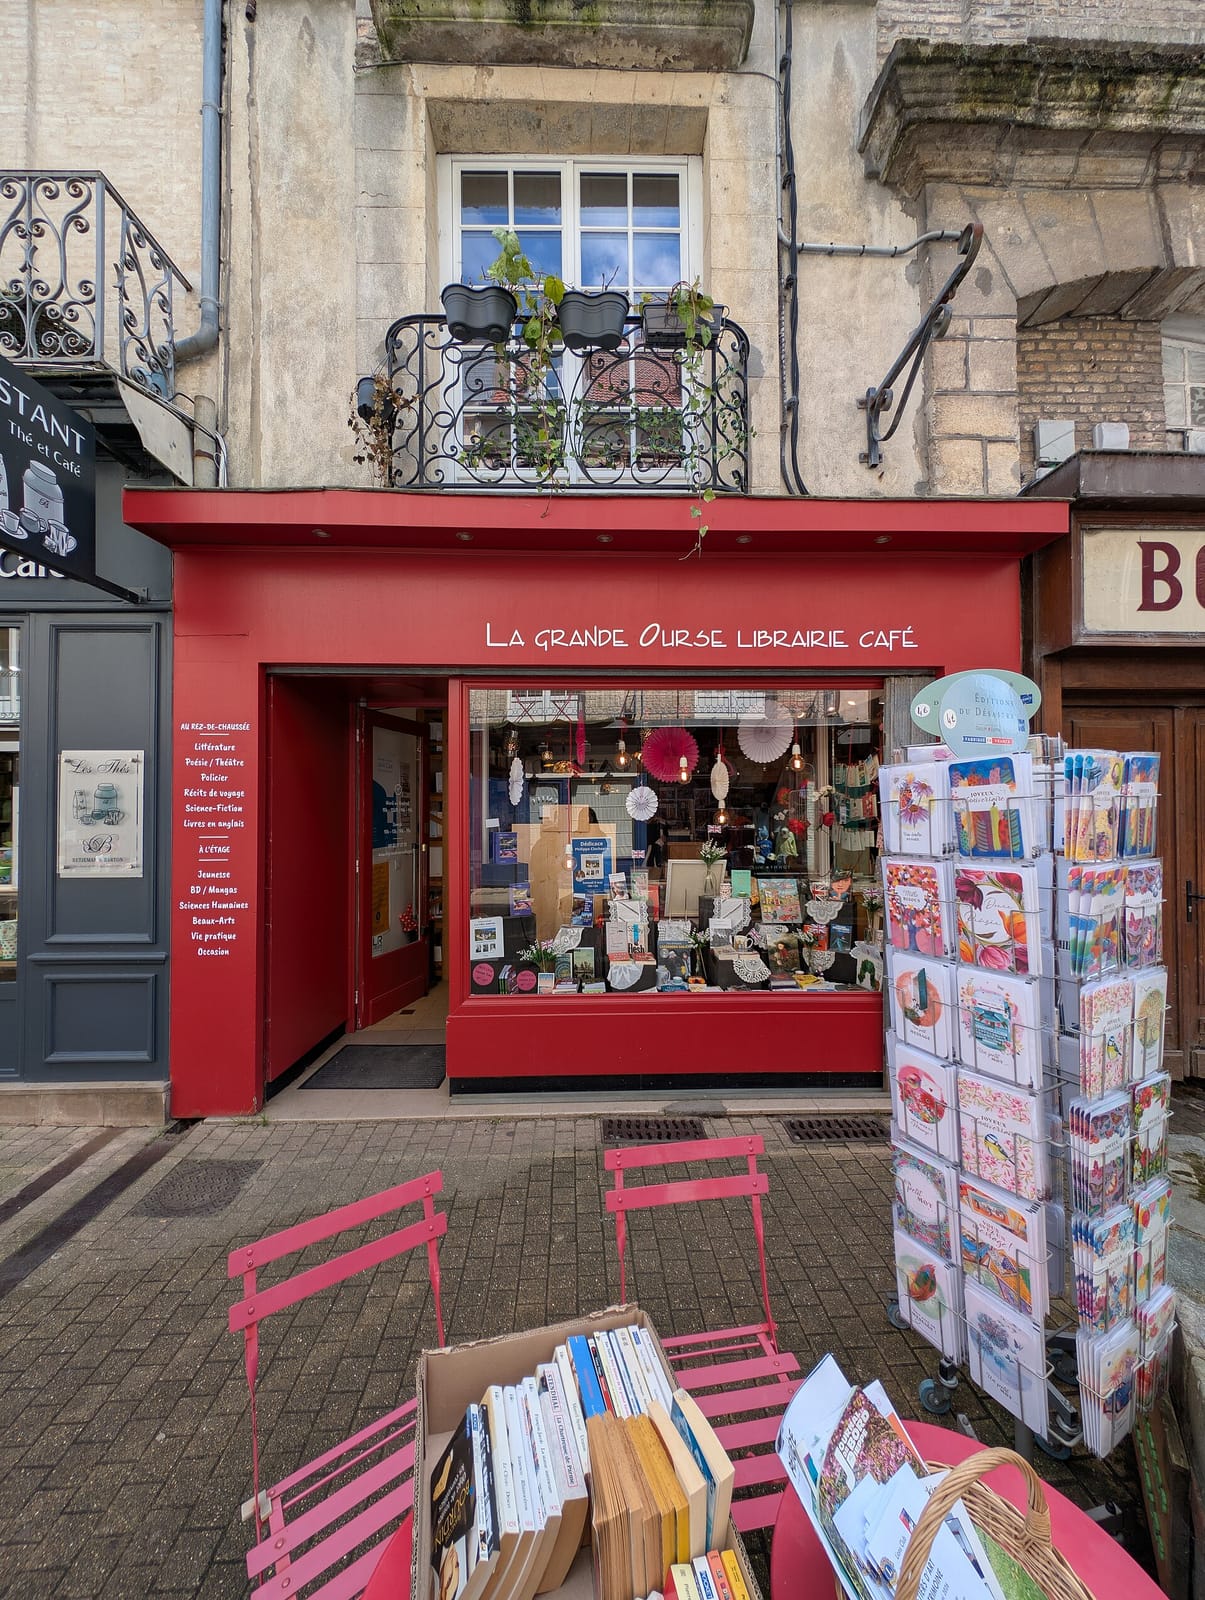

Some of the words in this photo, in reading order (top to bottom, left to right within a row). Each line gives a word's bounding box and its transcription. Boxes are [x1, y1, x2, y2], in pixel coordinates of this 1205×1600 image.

[8, 419, 33, 447] Thé
[37, 443, 49, 458] et
[53, 451, 80, 478] Café
[0, 548, 65, 578] Ca
[1136, 541, 1205, 611] B
[737, 630, 849, 648] LIBRAIRIE
[859, 626, 918, 651] CAFÉ
[180, 723, 190, 731] AU
[191, 722, 251, 731] REZ-DE-CHAUSSÉE
[194, 742, 236, 752] Littérature
[70, 759, 92, 774] Les
[97, 758, 130, 774] Thés
[184, 758, 208, 767] Poésie
[215, 757, 245, 767] Théâtre
[200, 773, 229, 782] Policier
[184, 788, 207, 797] Récits
[208, 789, 218, 797] de
[219, 790, 245, 799] voyage
[185, 803, 243, 812] Science-Fiction
[183, 819, 206, 828] Livres
[217, 819, 245, 829] anglais
[204, 845, 231, 853] L'ÉTAGE
[197, 869, 231, 879] Jeunesse
[190, 886, 201, 894] BD
[208, 886, 238, 896] Mangas
[179, 901, 210, 910] Sciences
[211, 900, 249, 909] Humaines
[192, 916, 235, 925] Beaux-Arts
[191, 931, 203, 941] Vie
[204, 931, 237, 942] pratique
[197, 947, 230, 956] Occasion
[547, 1373, 560, 1410] STENDHAL
[556, 1417, 562, 1425] La
[846, 1409, 871, 1452] BORD
